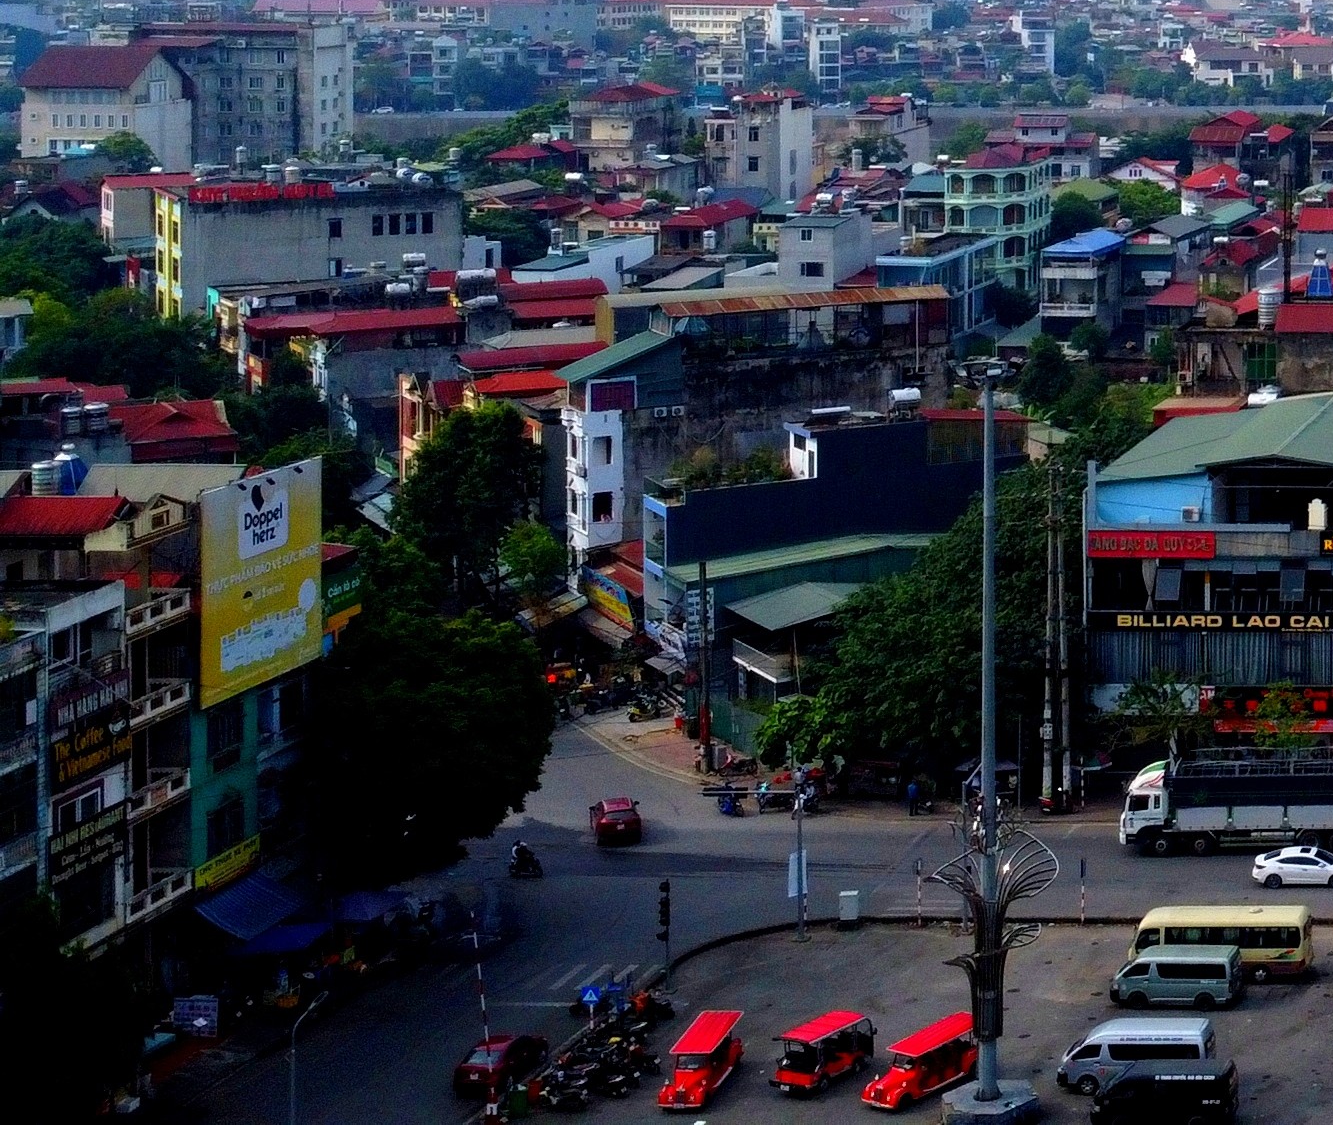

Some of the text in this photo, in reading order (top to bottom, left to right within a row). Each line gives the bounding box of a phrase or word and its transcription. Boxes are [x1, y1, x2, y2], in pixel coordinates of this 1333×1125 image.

[245, 502, 283, 531] Doppel
[253, 525, 276, 546] herz
[1117, 614, 1222, 628] BILLIARD
[1232, 615, 1281, 628] LAO
[1289, 615, 1330, 628] CAI
[54, 740, 71, 763] The
[74, 726, 105, 753] Coffee
